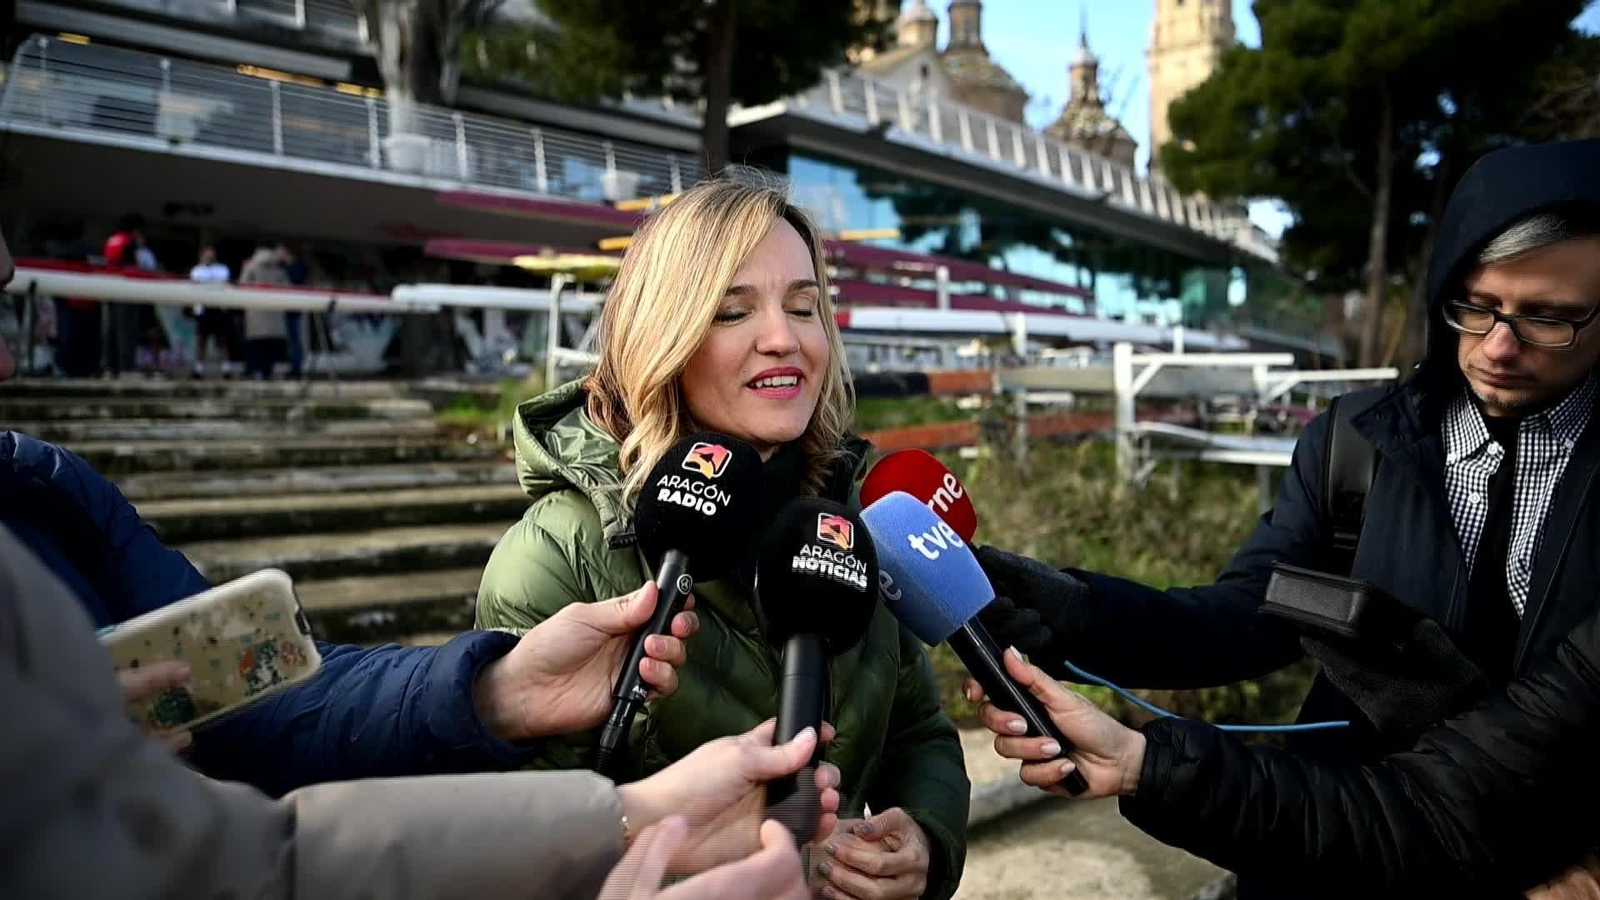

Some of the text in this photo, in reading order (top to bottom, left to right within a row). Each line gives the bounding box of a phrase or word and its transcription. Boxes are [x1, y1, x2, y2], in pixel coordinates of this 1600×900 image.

[656, 474, 731, 507] ARAGÓN
[657, 488, 717, 516] RADIO
[907, 521, 964, 560] tve
[792, 556, 868, 589] NOTICIAS
[800, 543, 867, 573] ARAGÓN
